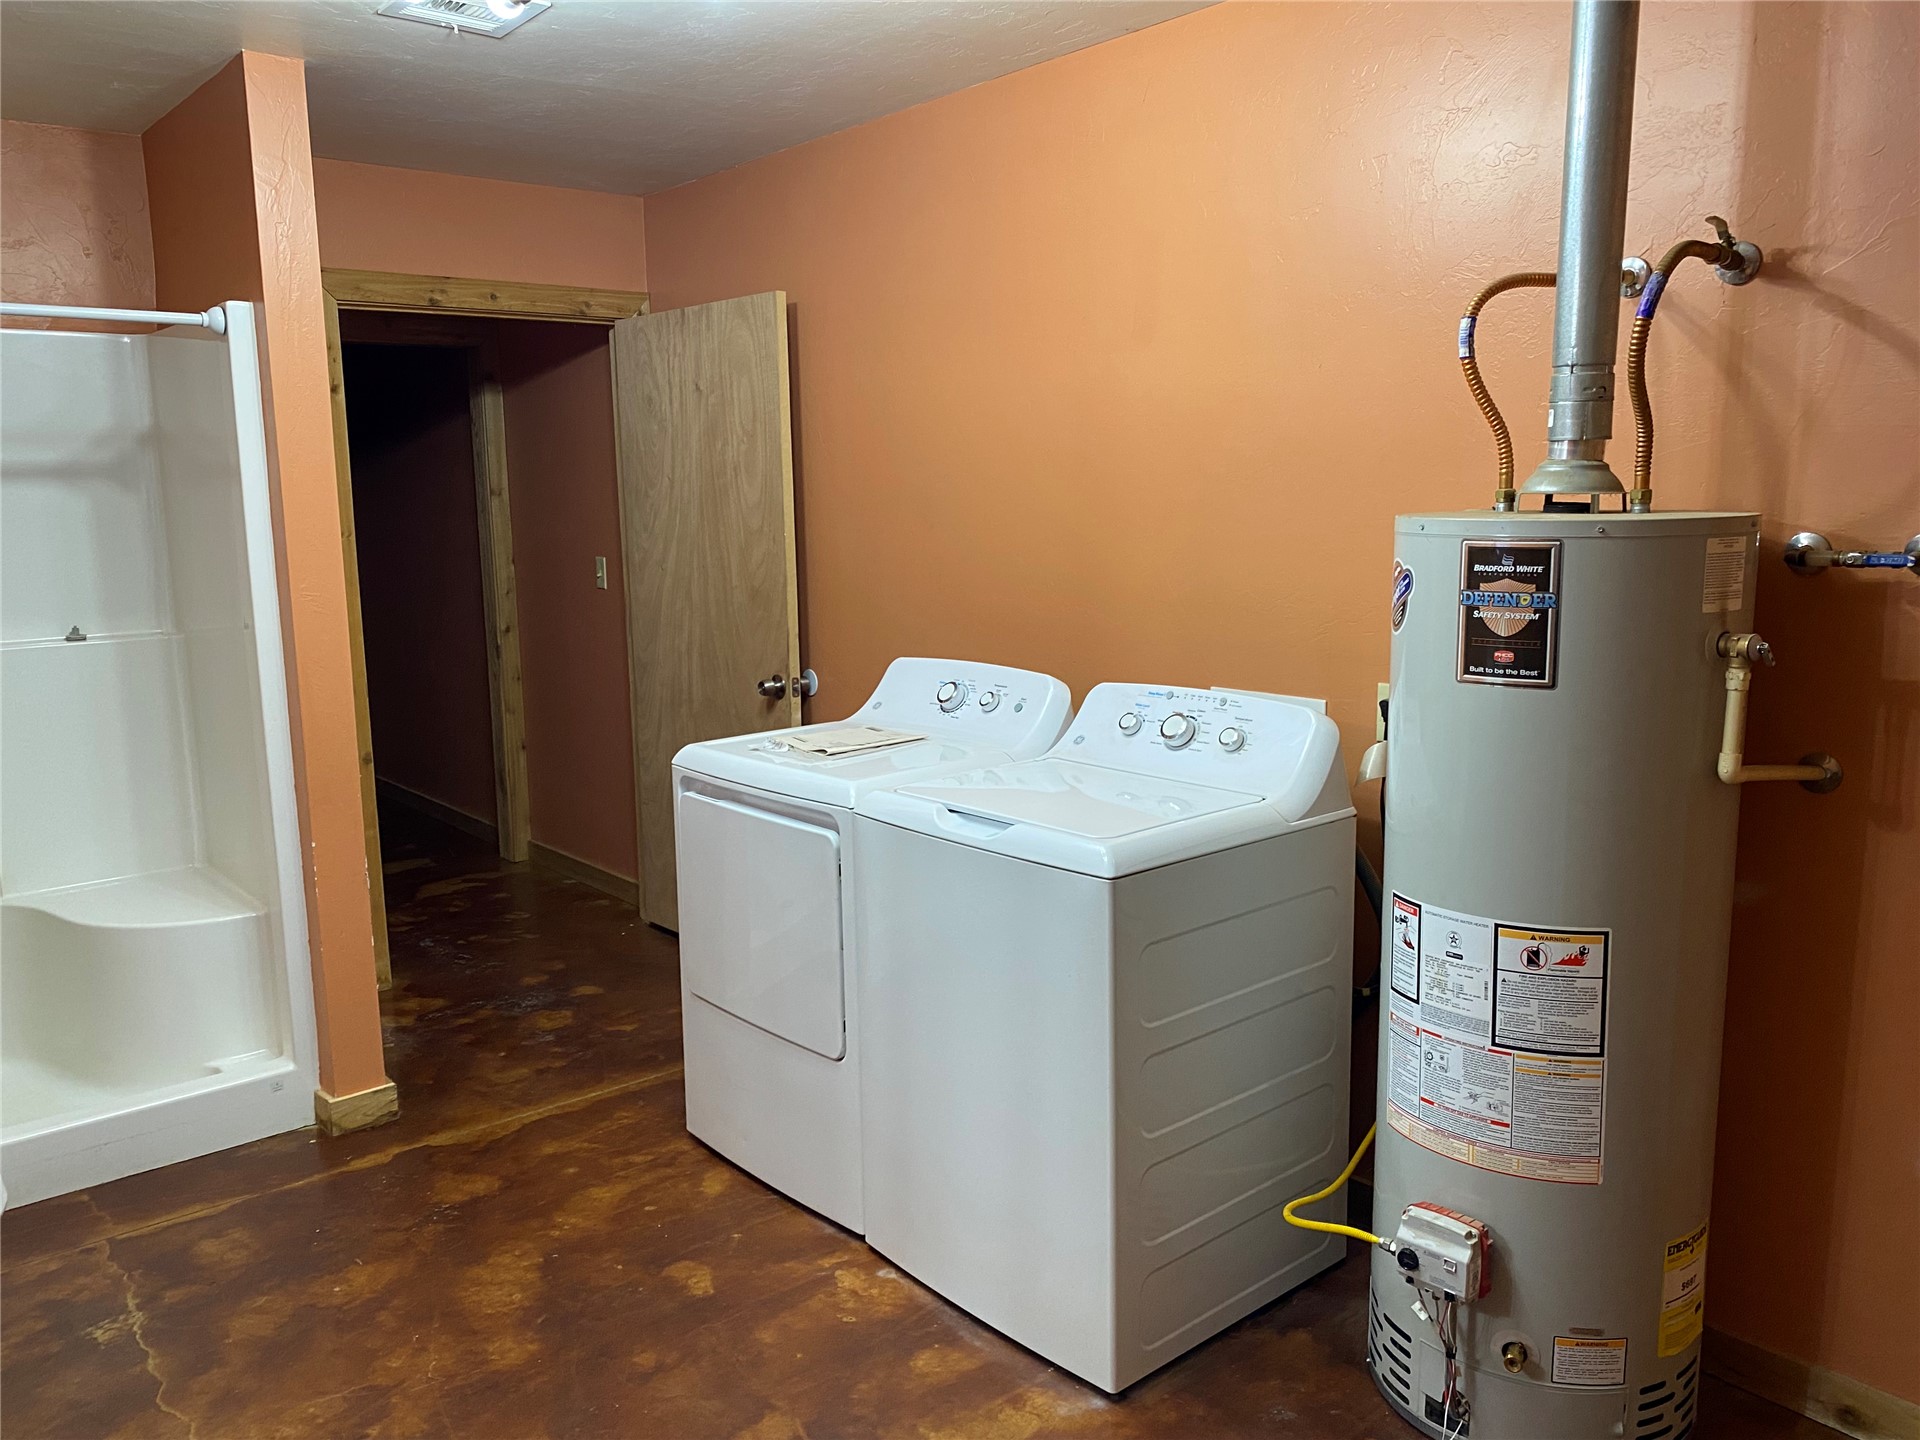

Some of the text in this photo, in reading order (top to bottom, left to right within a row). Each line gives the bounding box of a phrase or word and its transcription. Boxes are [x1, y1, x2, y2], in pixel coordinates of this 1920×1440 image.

[1473, 564, 1544, 573] BRADFORD WHITE
[1462, 590, 1557, 608] DEFENDER
[1473, 610, 1540, 621] SAFETY SYSTEM
[1469, 665, 1484, 673] Built
[1485, 666, 1493, 674] to
[1494, 667, 1504, 675] be
[1505, 668, 1518, 676] the
[1538, 935, 1571, 943] WARNING
